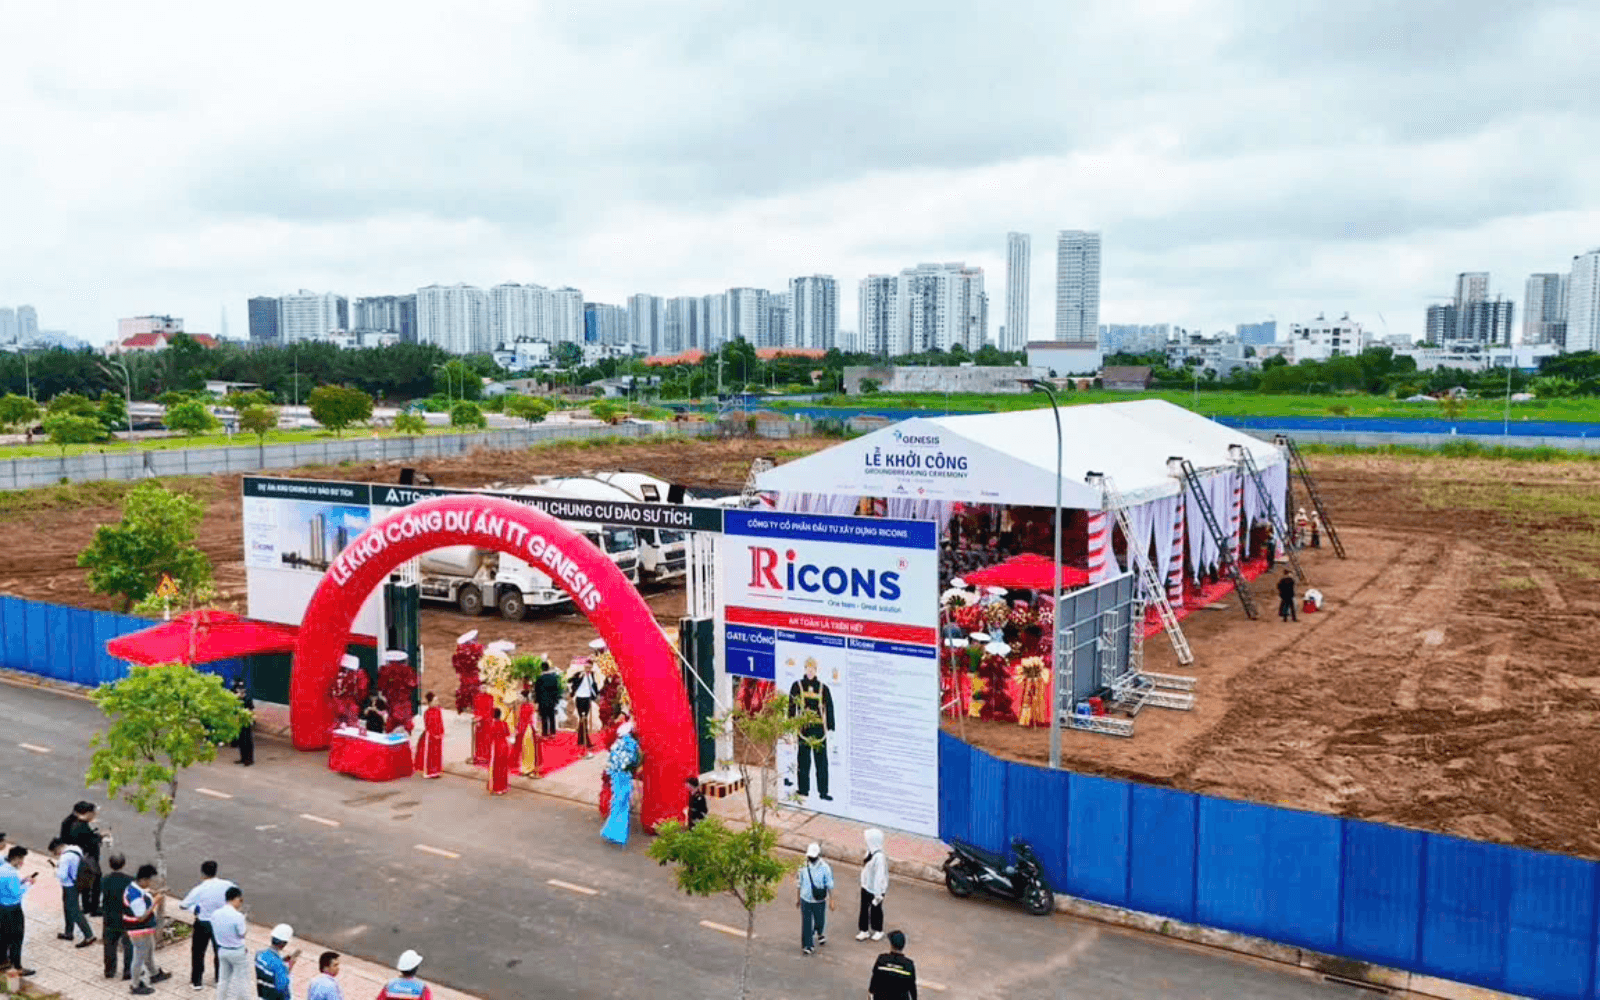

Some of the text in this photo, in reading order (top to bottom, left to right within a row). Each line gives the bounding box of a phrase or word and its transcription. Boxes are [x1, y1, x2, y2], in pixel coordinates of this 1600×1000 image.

[903, 435, 940, 445] GENESIS
[865, 446, 968, 470] LỄ KHỞI CÔNG
[864, 467, 968, 479] GROUNDBREAKING CEREMONY
[399, 491, 411, 502] TT
[550, 503, 593, 518] CHUNG
[594, 505, 614, 518] CƯ
[615, 504, 641, 521] ĐÀO
[643, 507, 662, 522] SƯ
[663, 508, 693, 525] TÍCH
[747, 518, 769, 529] CÔNG
[770, 521, 778, 529] TY
[879, 528, 908, 538] RICONS
[386, 511, 443, 542] CÔNG
[445, 510, 473, 535] DỰ
[474, 509, 505, 537] ÁN
[506, 520, 530, 547] TT
[527, 535, 602, 612] GENESIS
[747, 656, 754, 672] 1
